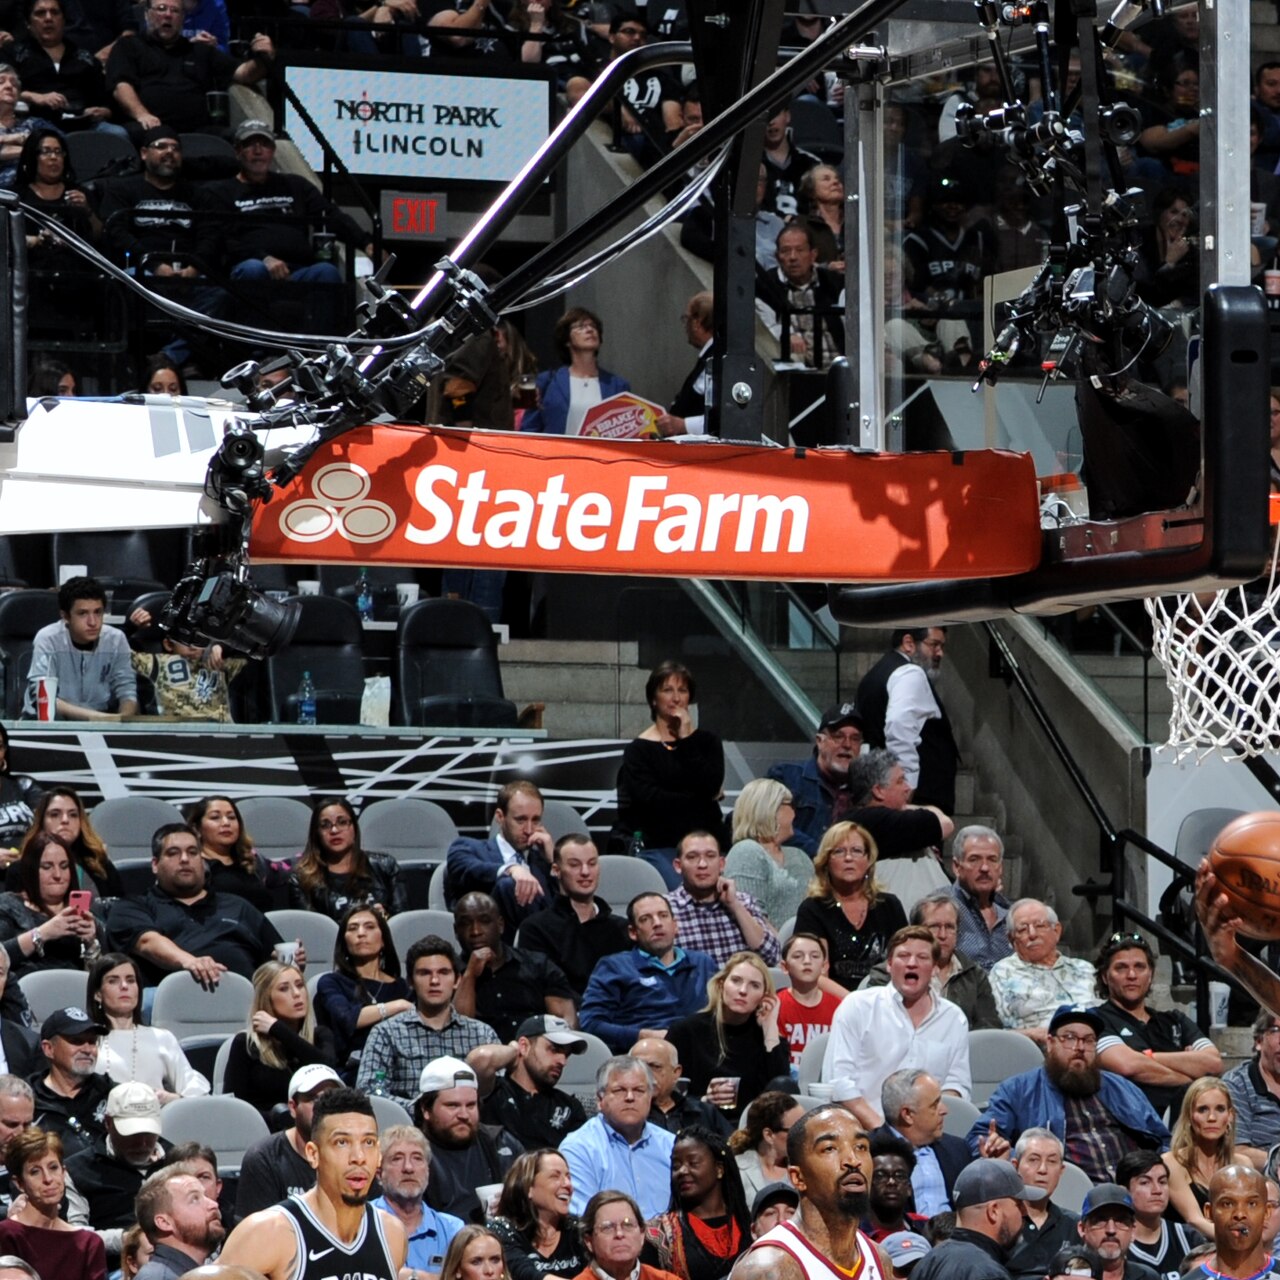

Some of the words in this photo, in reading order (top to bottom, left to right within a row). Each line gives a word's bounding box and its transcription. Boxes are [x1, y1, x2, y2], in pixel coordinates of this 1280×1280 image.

[334, 97, 425, 125] NORTH
[434, 104, 501, 129] PARK
[367, 130, 485, 159] LINCOLN
[391, 197, 438, 235] EXIT
[595, 410, 635, 432] BRAKE
[599, 420, 637, 439] CHECK
[168, 657, 190, 687] 9
